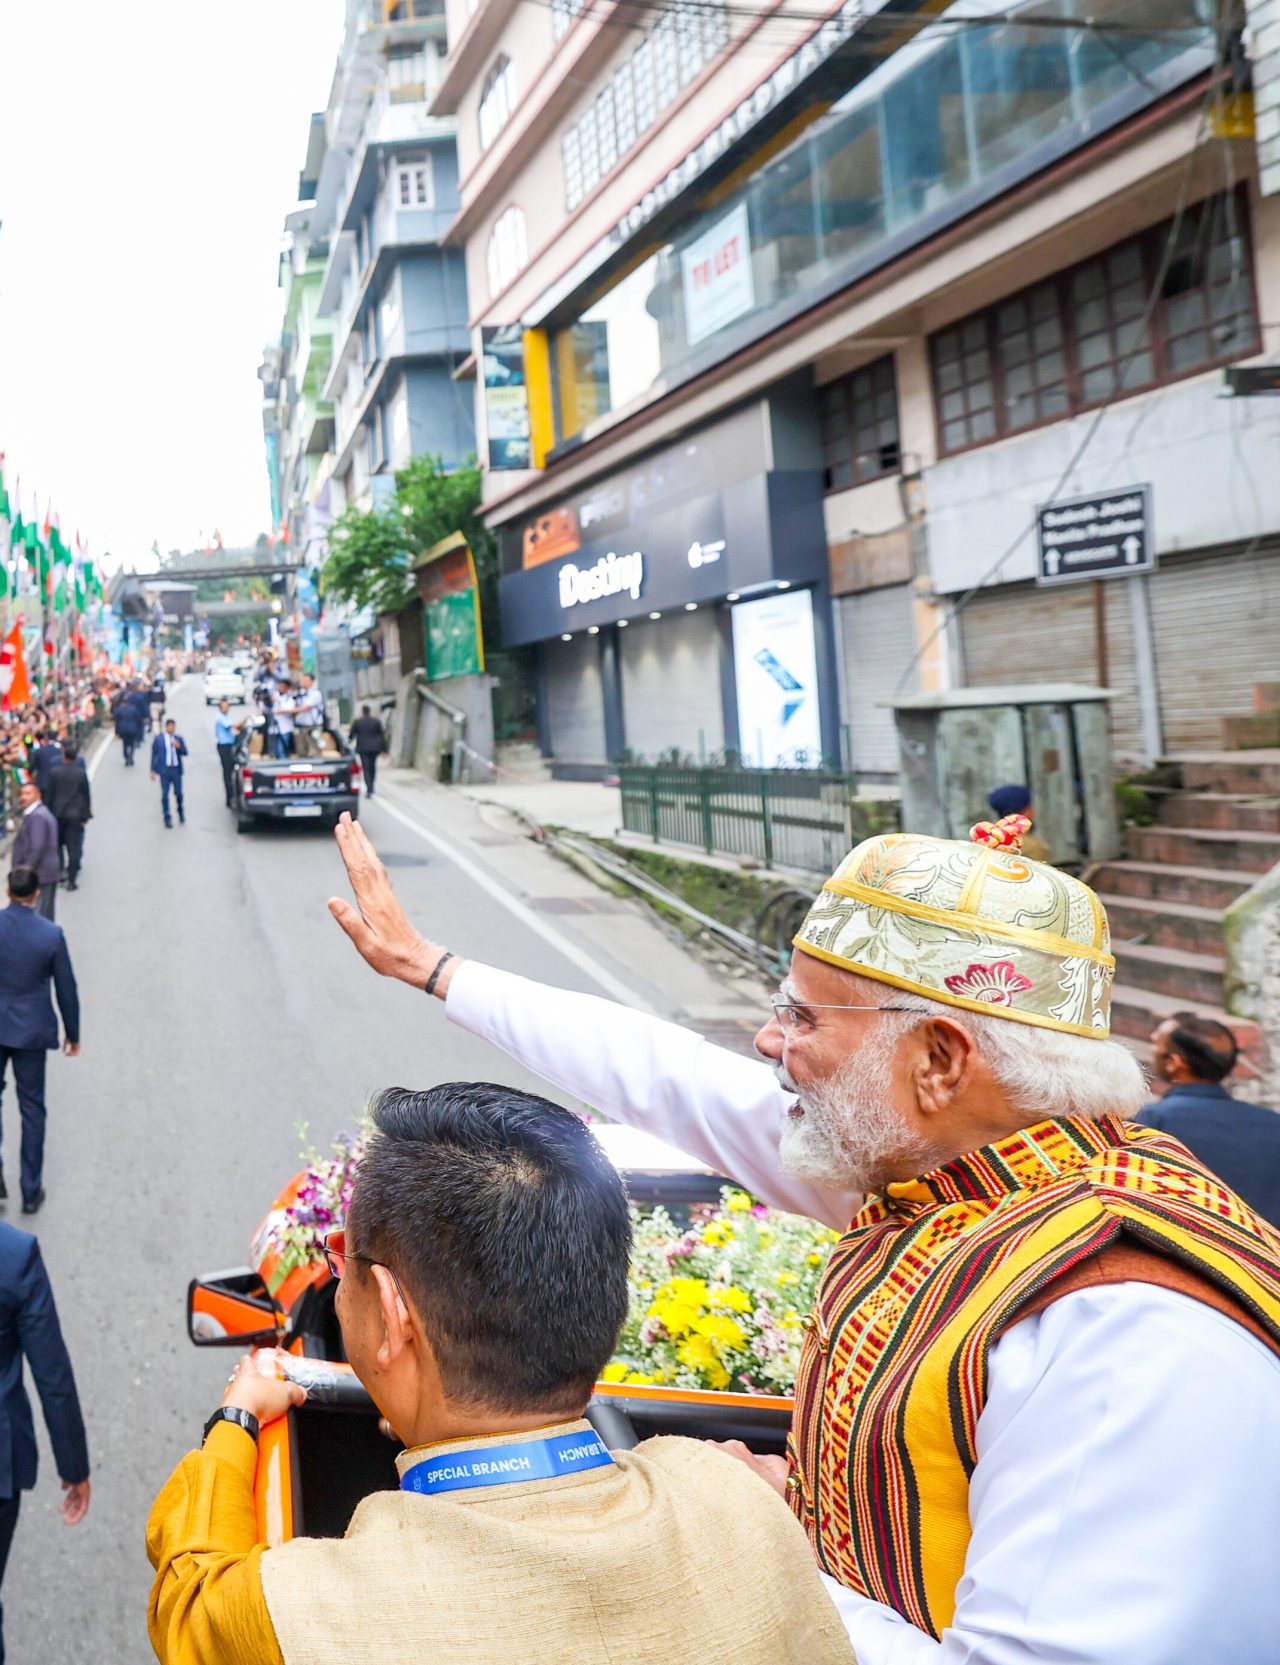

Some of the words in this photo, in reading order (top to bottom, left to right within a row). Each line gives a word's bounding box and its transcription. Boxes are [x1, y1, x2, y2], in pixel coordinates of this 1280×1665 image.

[714, 235, 741, 276] LET
[275, 776, 330, 789] ISUZU
[558, 1443, 600, 1462] BRANCH
[427, 1465, 471, 1484] SPECIAL
[472, 1456, 530, 1475] BRANCH
